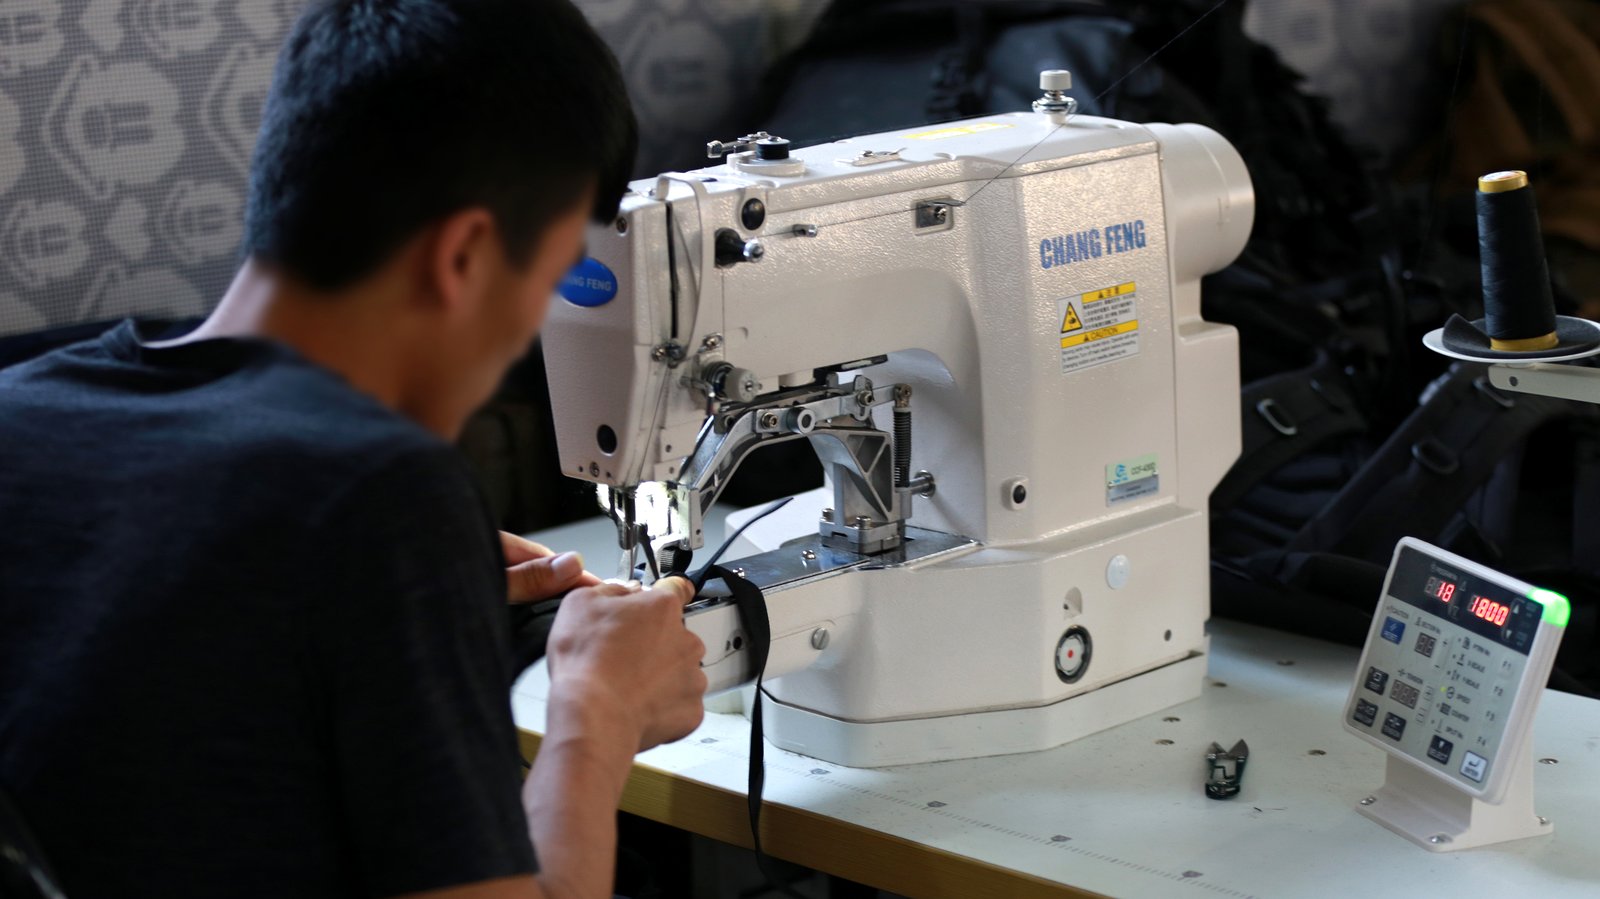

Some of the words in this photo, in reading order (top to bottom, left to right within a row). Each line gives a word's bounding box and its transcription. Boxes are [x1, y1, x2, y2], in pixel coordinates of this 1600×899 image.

[1040, 228, 1102, 269] CHANG
[1105, 219, 1146, 255] FENG
[586, 278, 612, 291] FENG
[1436, 581, 1456, 603] 18
[1471, 596, 1510, 627] 1800
